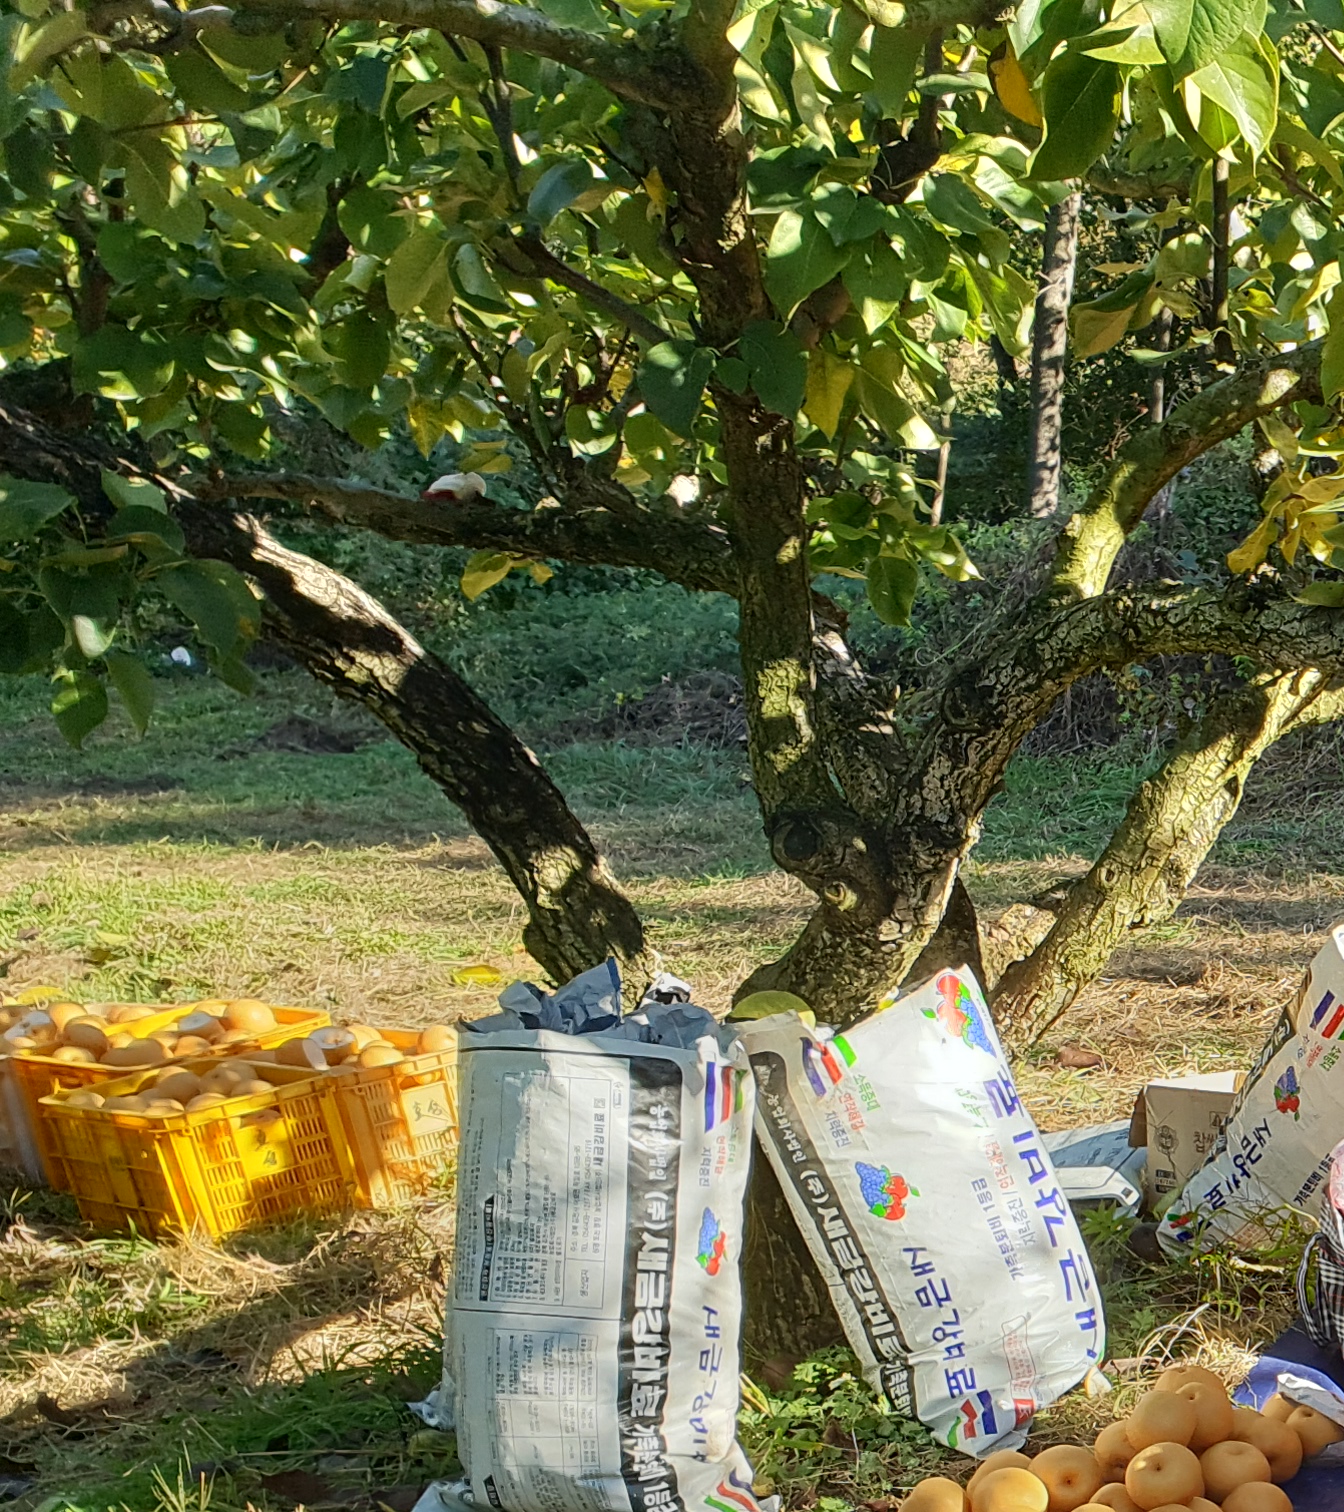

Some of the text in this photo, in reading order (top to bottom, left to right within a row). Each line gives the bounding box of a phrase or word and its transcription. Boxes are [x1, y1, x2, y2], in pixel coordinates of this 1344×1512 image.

[852, 1073, 880, 1111] 소득증대
[699, 1147, 710, 1188] 지력증진
[973, 1176, 1025, 1281] 가축분퇴비 1등급
[689, 1305, 724, 1463] 새금강비
